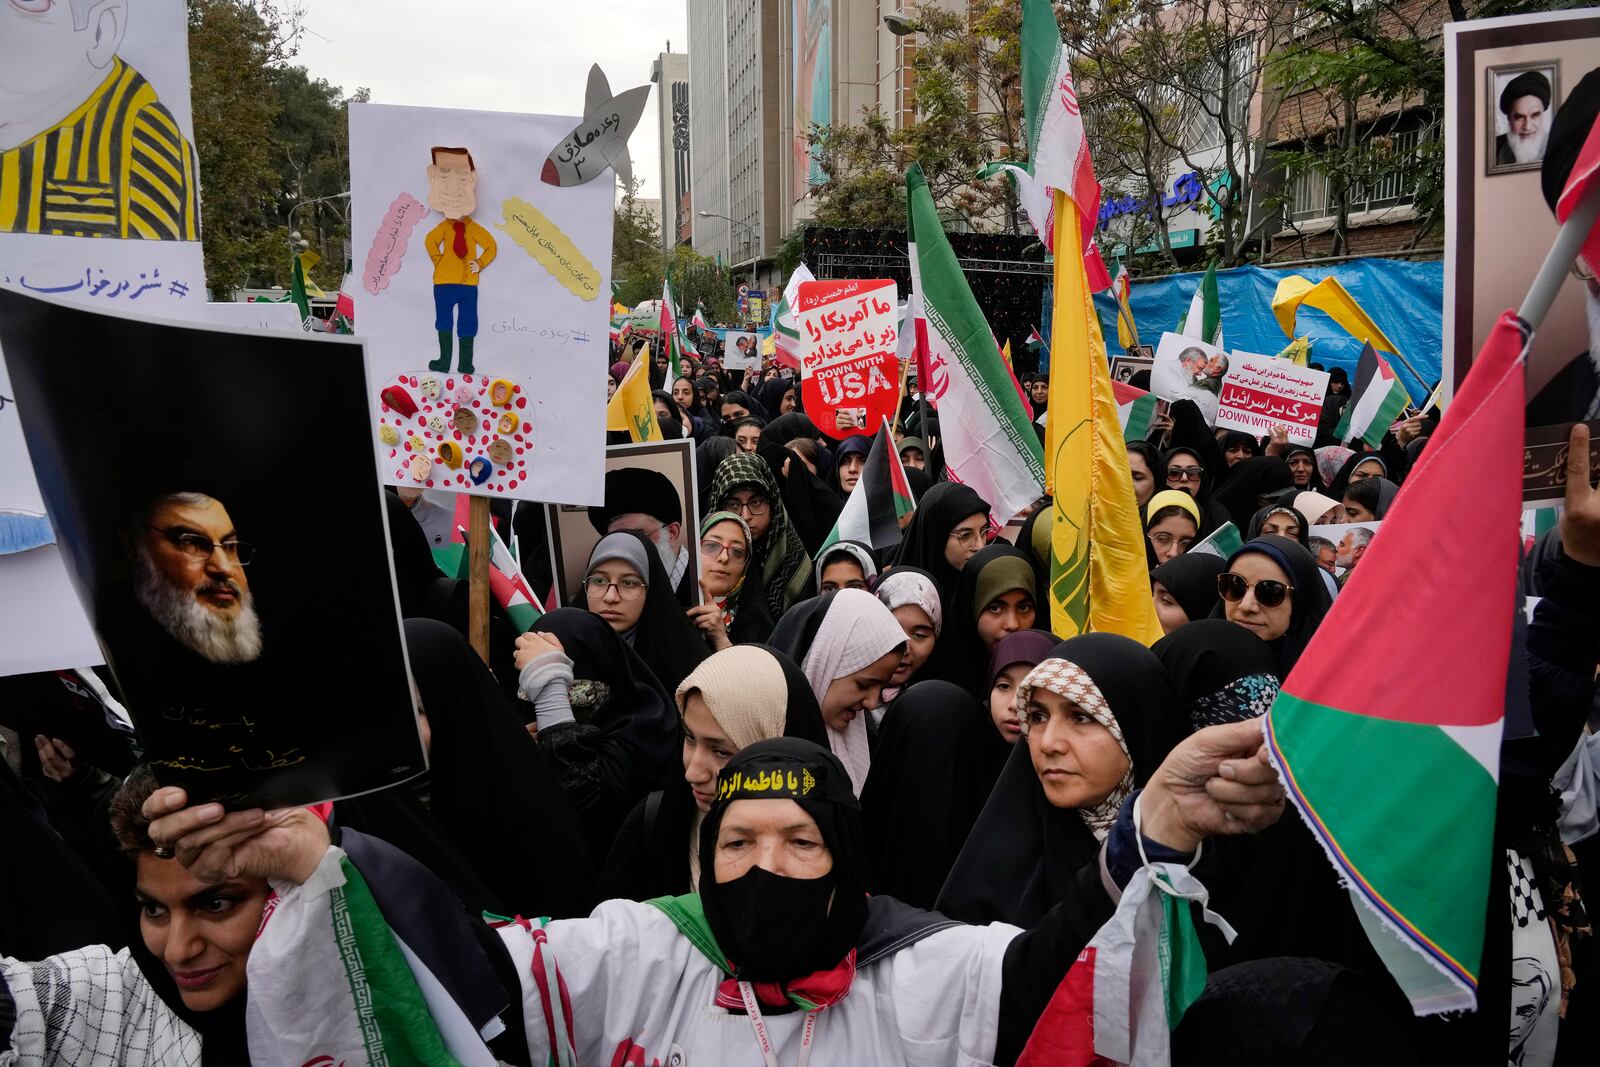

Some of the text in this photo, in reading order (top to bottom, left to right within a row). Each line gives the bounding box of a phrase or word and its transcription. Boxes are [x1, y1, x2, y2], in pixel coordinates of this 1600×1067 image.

[558, 131, 595, 163] صادق
[820, 288, 843, 303] خمینی
[844, 282, 859, 296] امام
[805, 297, 891, 342] ما آمریکا را
[864, 331, 875, 350] پا
[879, 325, 897, 346] زیر
[817, 355, 885, 381] DOWN WITH
[818, 366, 893, 405] USA
[1222, 388, 1270, 410] اسرائیل
[1265, 404, 1284, 416] بر
[1218, 408, 1250, 424] DOWN
[1252, 416, 1276, 428] WITH
[1286, 403, 1317, 422] مرگ
[743, 769, 784, 791] فاطمه
[787, 770, 798, 795] یا
[756, 1022, 770, 1053] Sony
[803, 1014, 816, 1046] Sony
